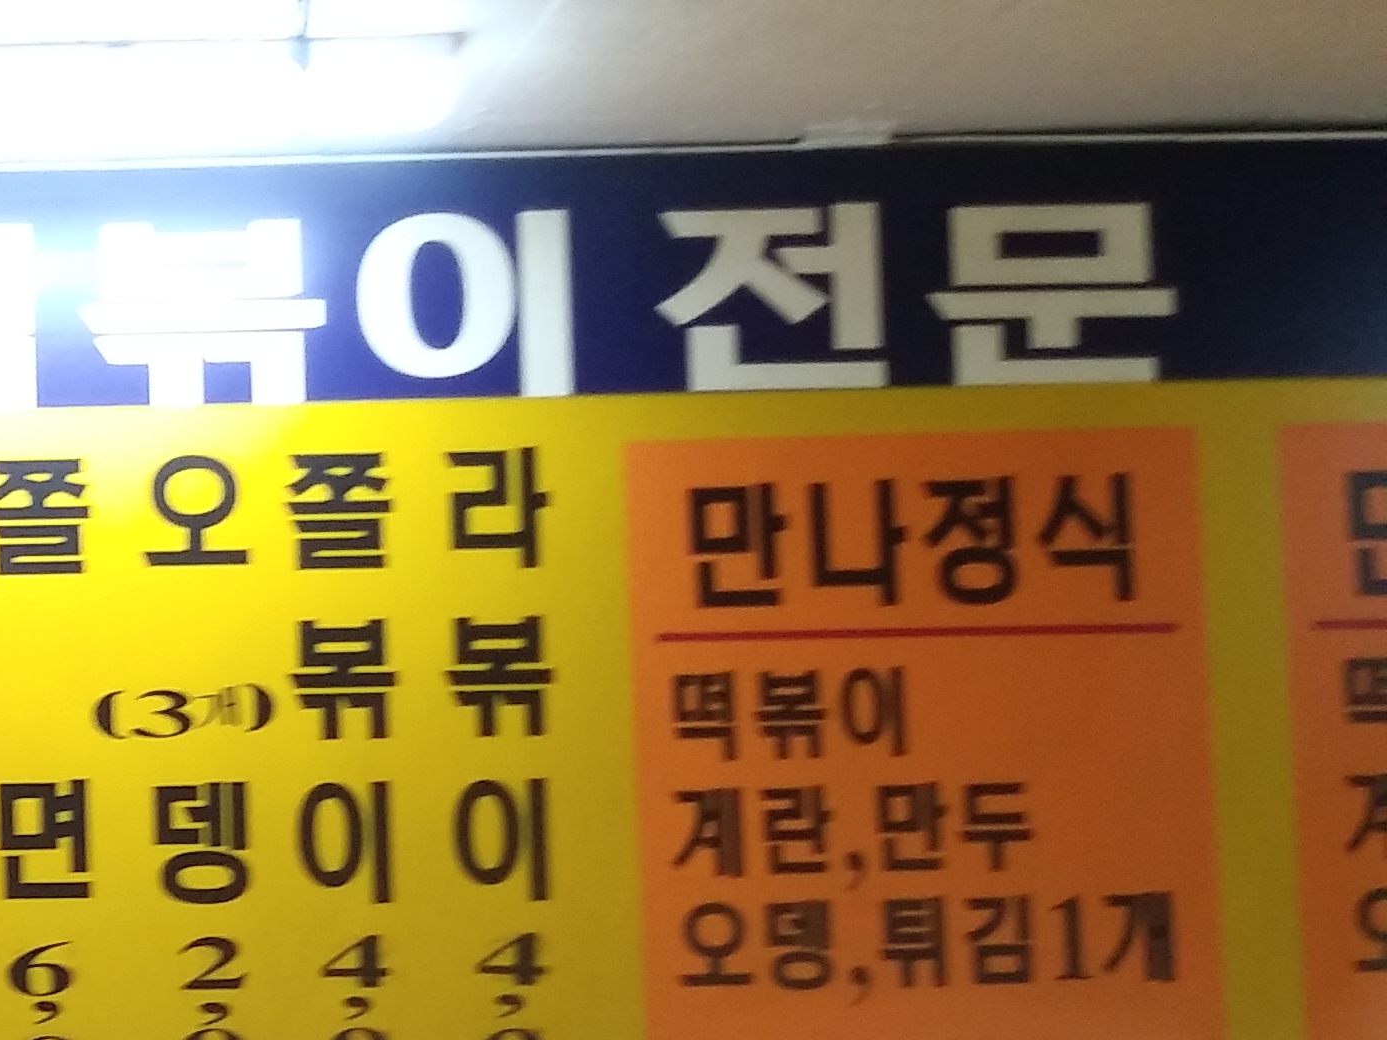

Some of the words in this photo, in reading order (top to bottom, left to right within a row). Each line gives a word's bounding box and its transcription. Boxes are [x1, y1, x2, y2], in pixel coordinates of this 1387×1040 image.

[654, 202, 1178, 392] 전문
[686, 470, 1136, 608] 만나정식
[91, 682, 278, 740] (3개)
[285, 451, 398, 904] 쫄볶이
[444, 446, 555, 902] 라볶이
[670, 667, 911, 761] 떡볶이
[670, 782, 1036, 891] 계란,만두
